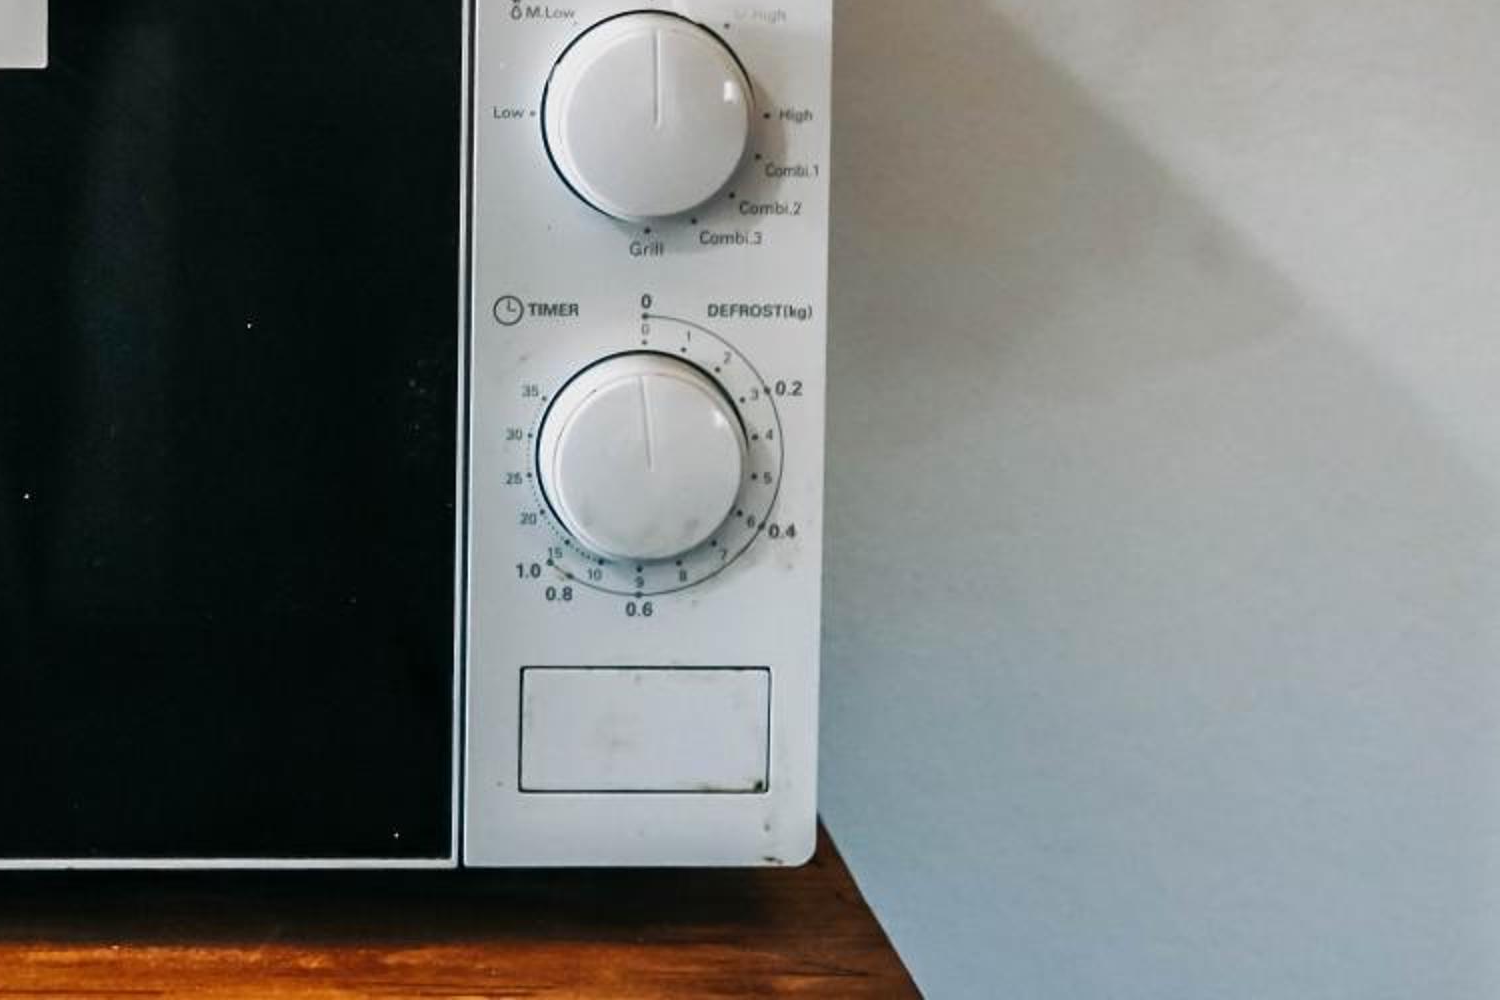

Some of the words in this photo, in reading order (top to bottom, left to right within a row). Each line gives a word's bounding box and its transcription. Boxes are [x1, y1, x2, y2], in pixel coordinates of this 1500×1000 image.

[525, 7, 575, 19] M.Low
[493, 107, 525, 120] Low
[779, 109, 813, 123] High
[765, 164, 819, 178] Combi.1
[739, 202, 801, 215] Combi.2
[700, 231, 762, 245] Combi.3
[629, 242, 664, 257] Grill
[641, 294, 652, 310] 0
[528, 303, 579, 317] TIMER
[707, 303, 813, 320] DEFROST(kg)
[723, 352, 732, 364] 2
[522, 385, 539, 397] 35
[775, 381, 803, 396] 0.2
[506, 429, 523, 441] 30
[765, 429, 773, 441] 4
[506, 473, 523, 485] 25
[763, 473, 772, 485] 5
[520, 513, 537, 525] 20
[768, 523, 796, 539] 0.4
[516, 563, 541, 578] 1.0
[588, 569, 601, 581] 10
[545, 586, 573, 602] 0.8
[625, 602, 653, 618] 0.6
